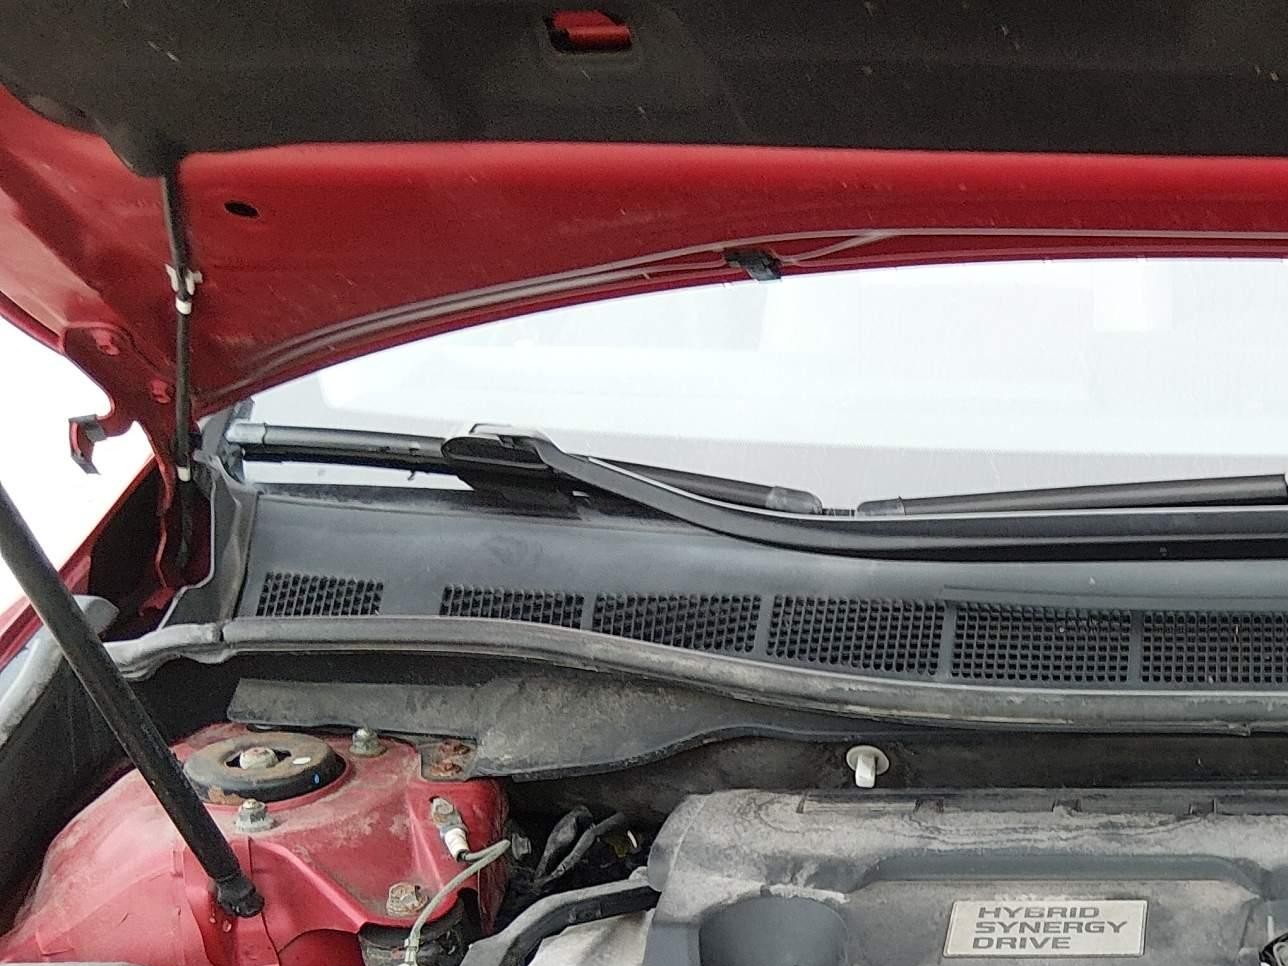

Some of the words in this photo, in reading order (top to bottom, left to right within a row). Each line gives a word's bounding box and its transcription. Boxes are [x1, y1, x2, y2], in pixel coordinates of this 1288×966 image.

[978, 907, 1100, 919] HYBRID
[975, 921, 1128, 934] SYNERGY
[972, 936, 1071, 949] DRIVE
